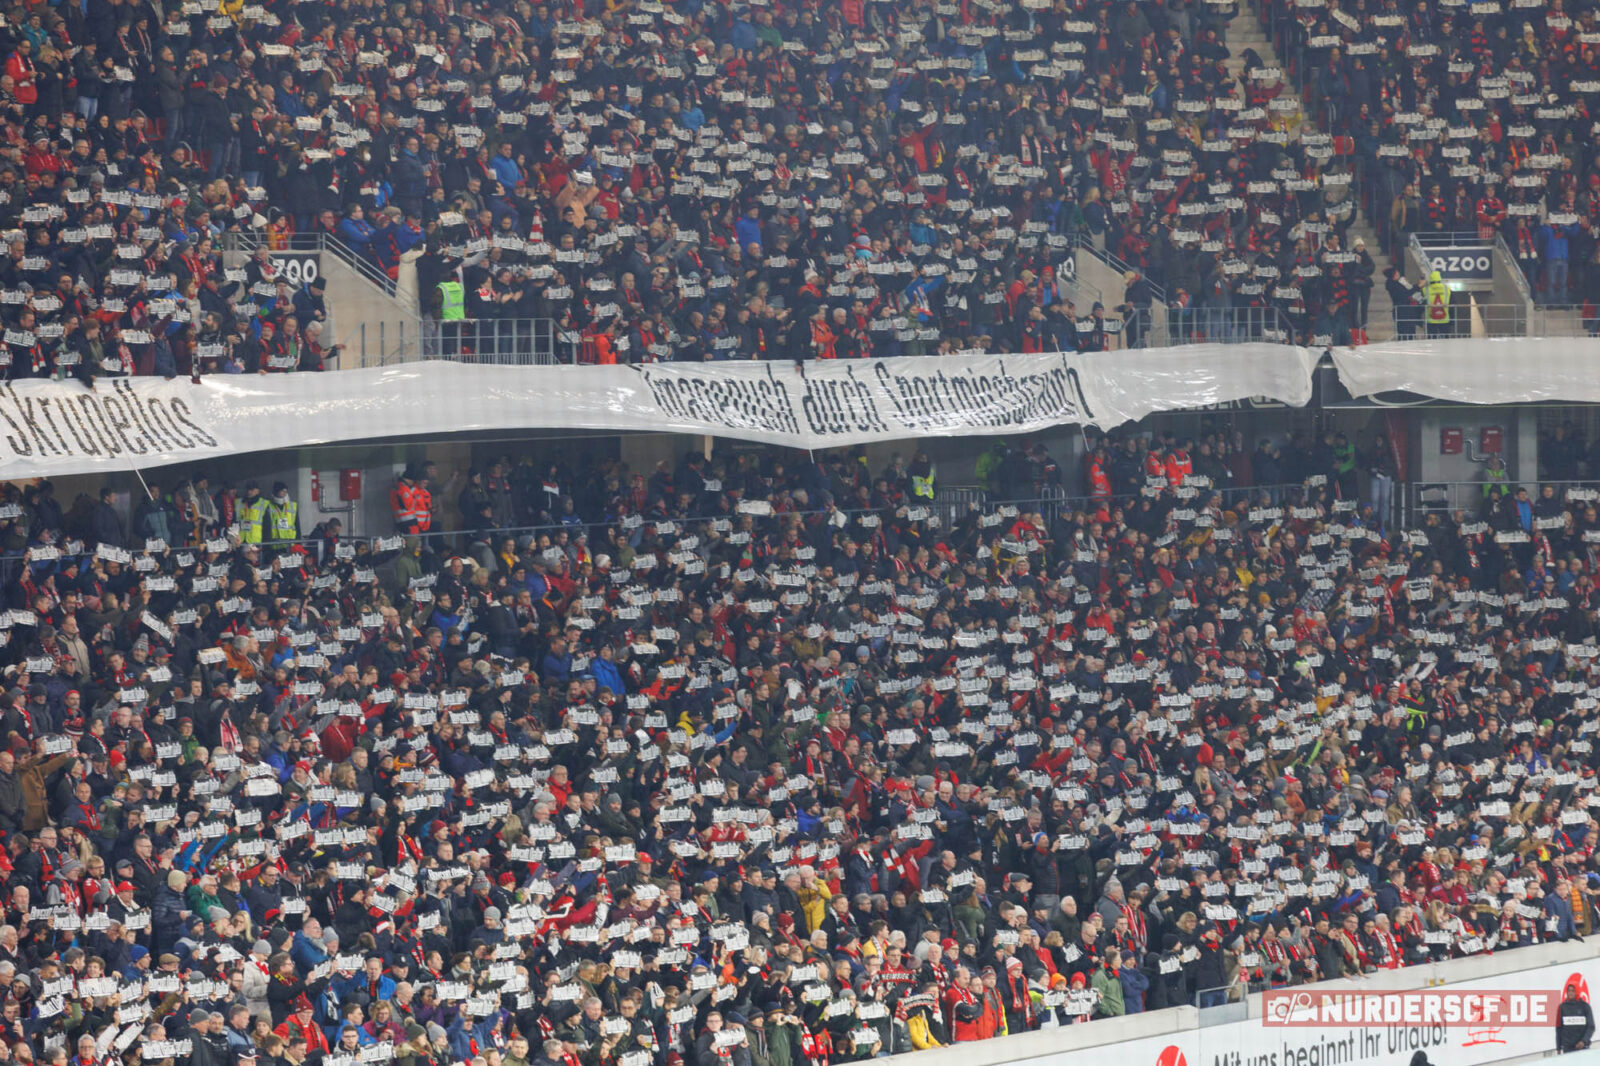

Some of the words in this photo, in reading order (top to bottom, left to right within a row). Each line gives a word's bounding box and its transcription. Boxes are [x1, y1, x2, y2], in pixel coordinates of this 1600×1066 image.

[1431, 256, 1490, 271] AZOO
[801, 361, 888, 434] durch
[1284, 1030, 1355, 1066] beginnt
[1360, 1026, 1381, 1059] Ihr
[1388, 1013, 1447, 1054] Urlaub!
